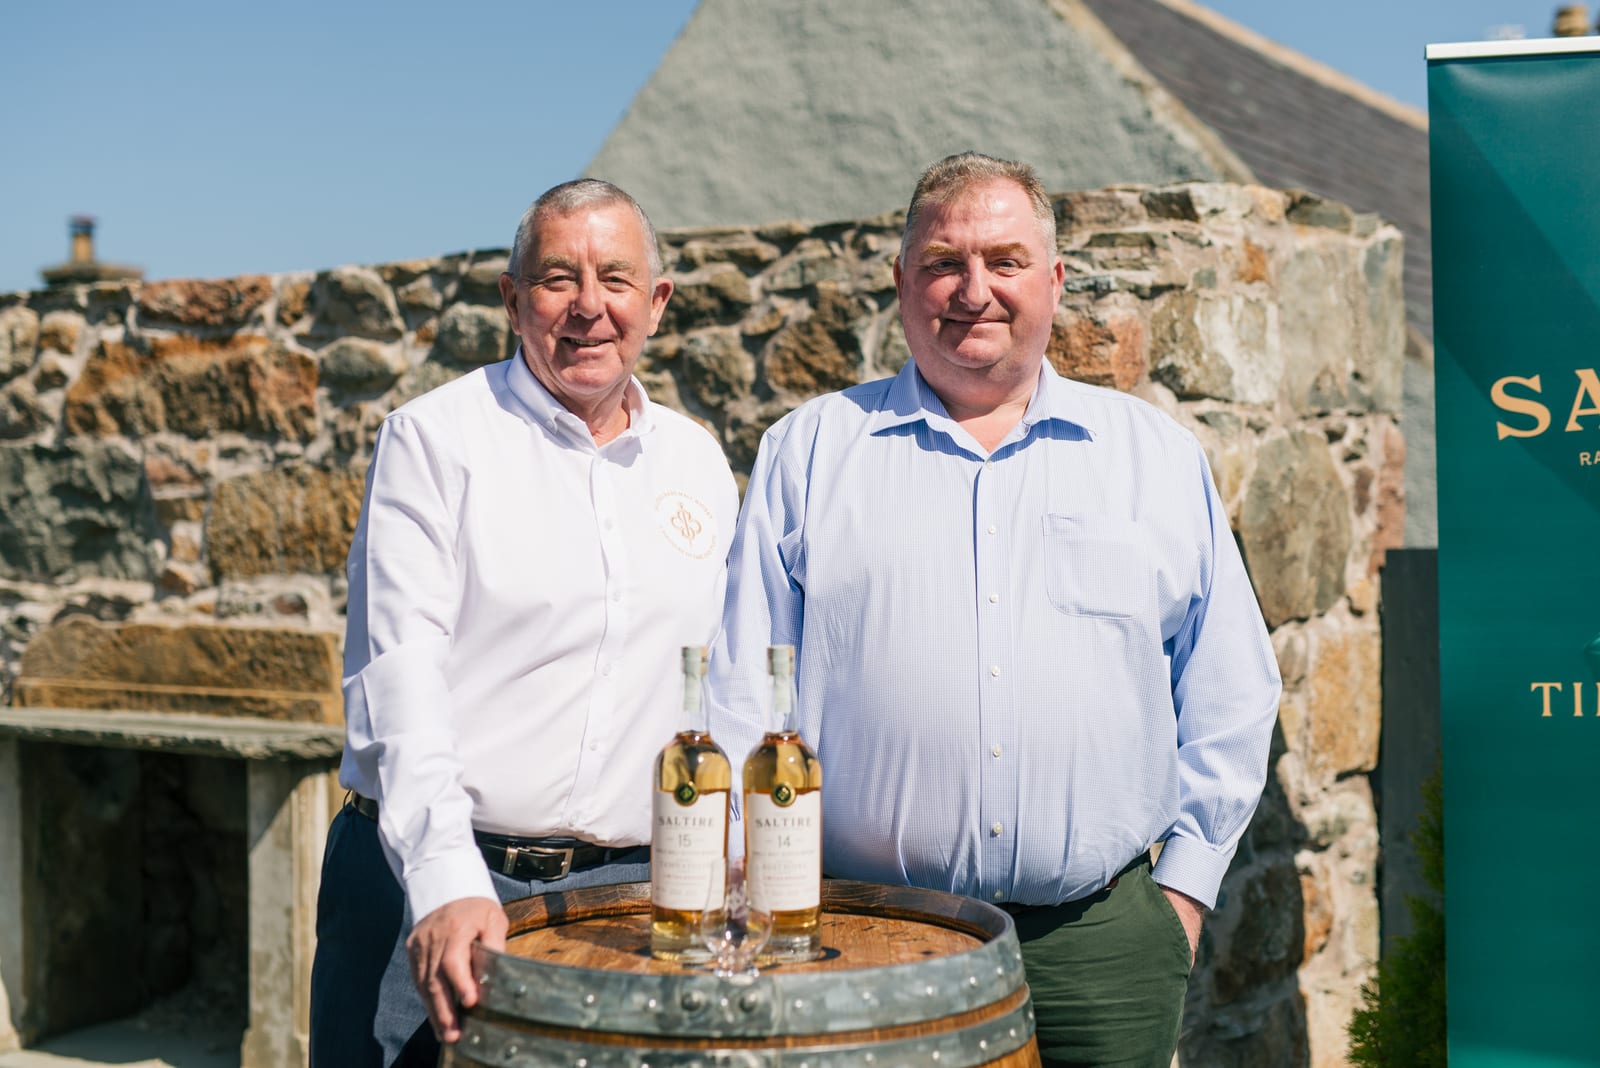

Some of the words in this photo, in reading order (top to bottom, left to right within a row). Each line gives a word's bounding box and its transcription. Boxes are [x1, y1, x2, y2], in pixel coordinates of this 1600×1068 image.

[1490, 368, 1600, 441] SA
[1531, 682, 1600, 717] TI
[658, 815, 715, 827] SALTIRE
[755, 817, 811, 828] SALTIRE
[678, 833, 692, 848] 15
[777, 834, 791, 849] 14
